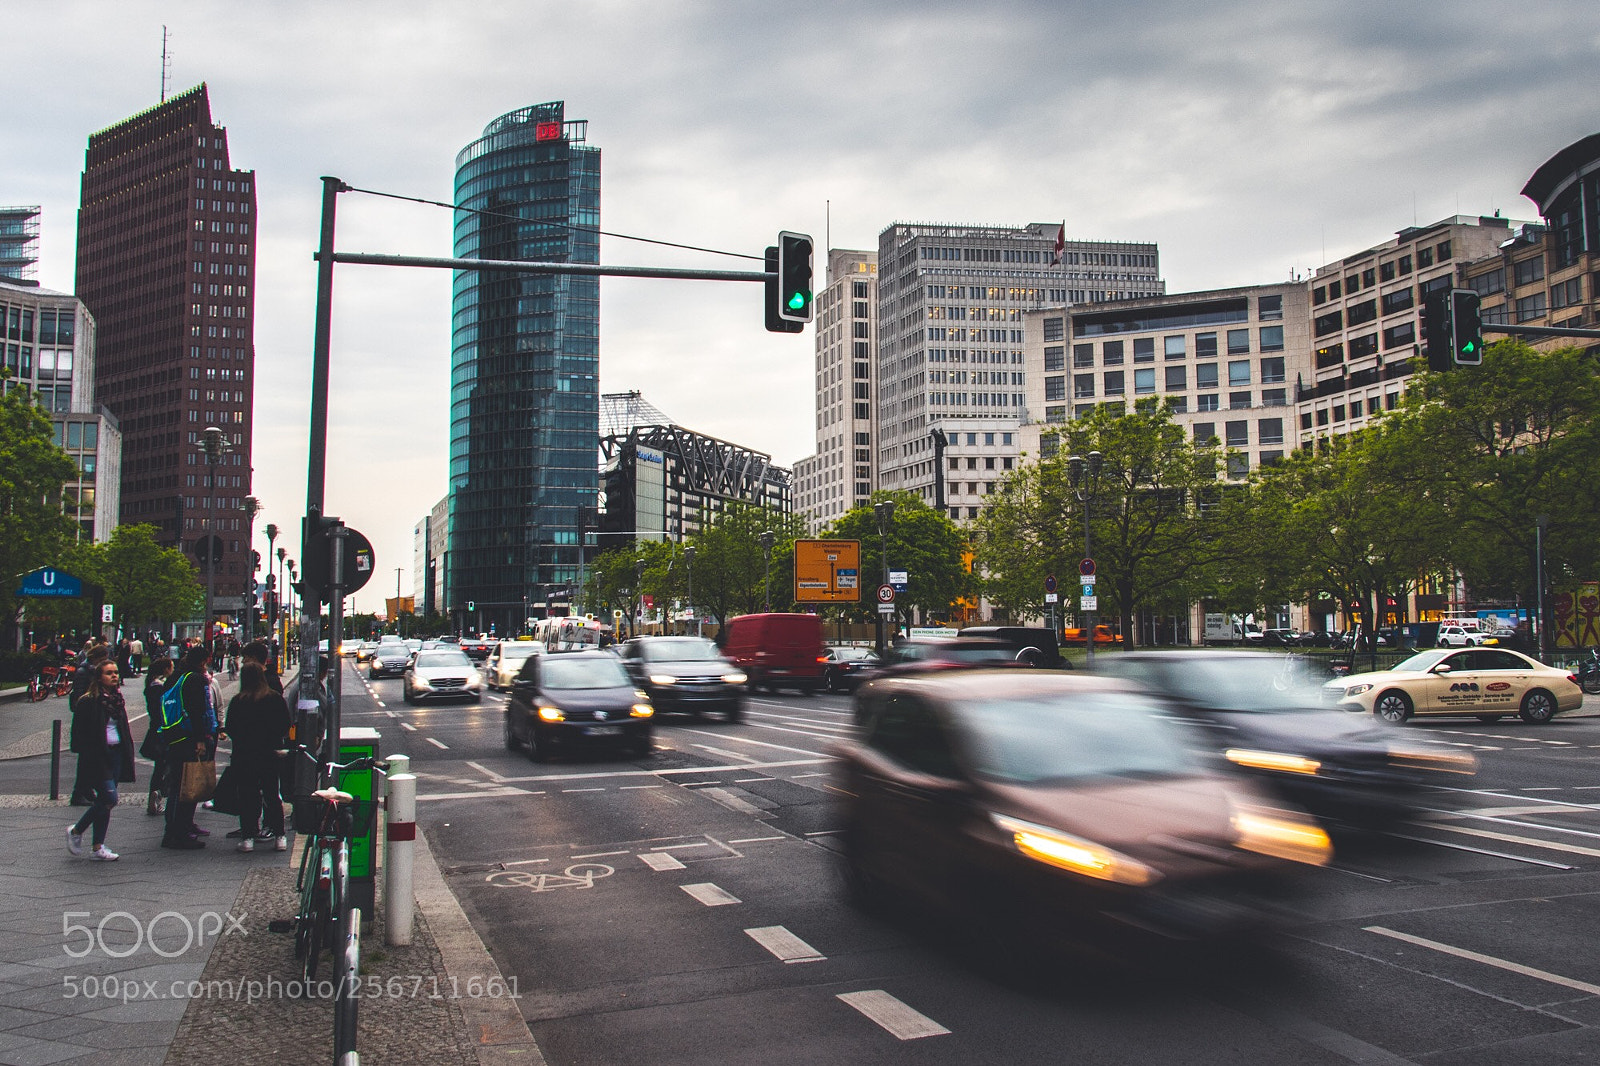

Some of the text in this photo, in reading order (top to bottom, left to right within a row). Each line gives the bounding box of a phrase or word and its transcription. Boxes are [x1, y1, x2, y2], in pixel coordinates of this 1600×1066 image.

[541, 124, 557, 137] DB
[43, 571, 55, 586] U
[24, 587, 73, 595] Potsdamer Platz
[881, 590, 891, 598] 30
